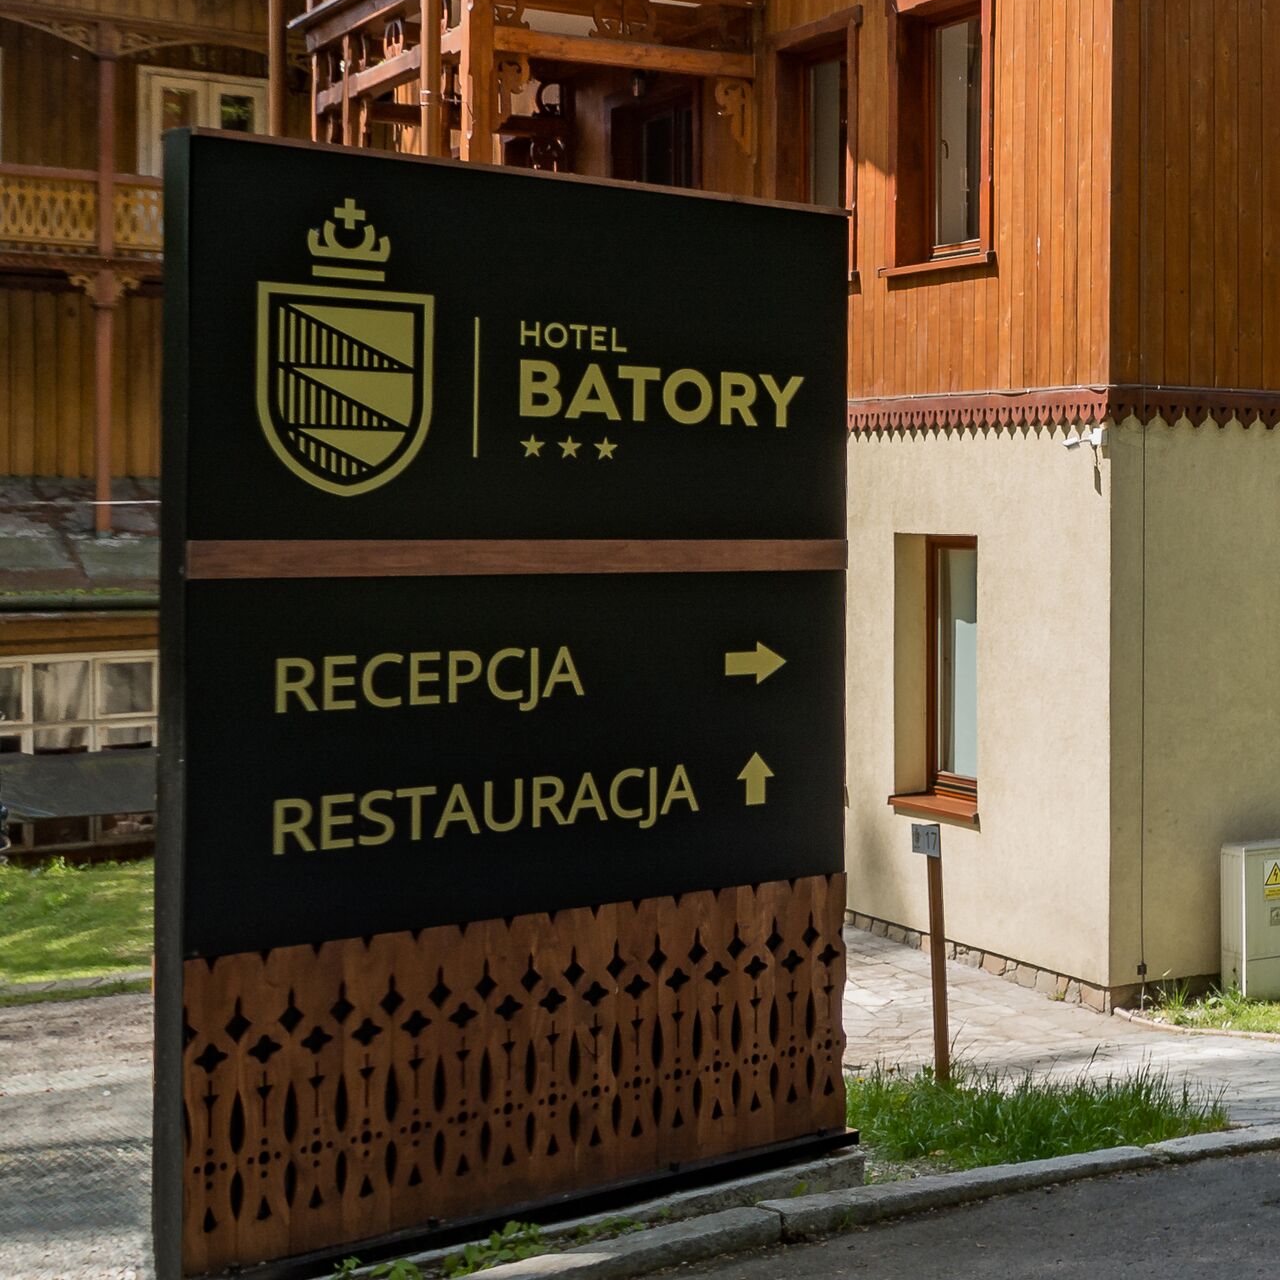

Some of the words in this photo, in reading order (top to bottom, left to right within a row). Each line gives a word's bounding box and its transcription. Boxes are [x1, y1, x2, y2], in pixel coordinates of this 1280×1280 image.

[520, 321, 628, 353] HOTEL
[519, 360, 805, 428] BATORY
[275, 646, 585, 713] RECEPCJA
[273, 765, 699, 855] RESTAURACJA
[925, 831, 937, 851] 17
